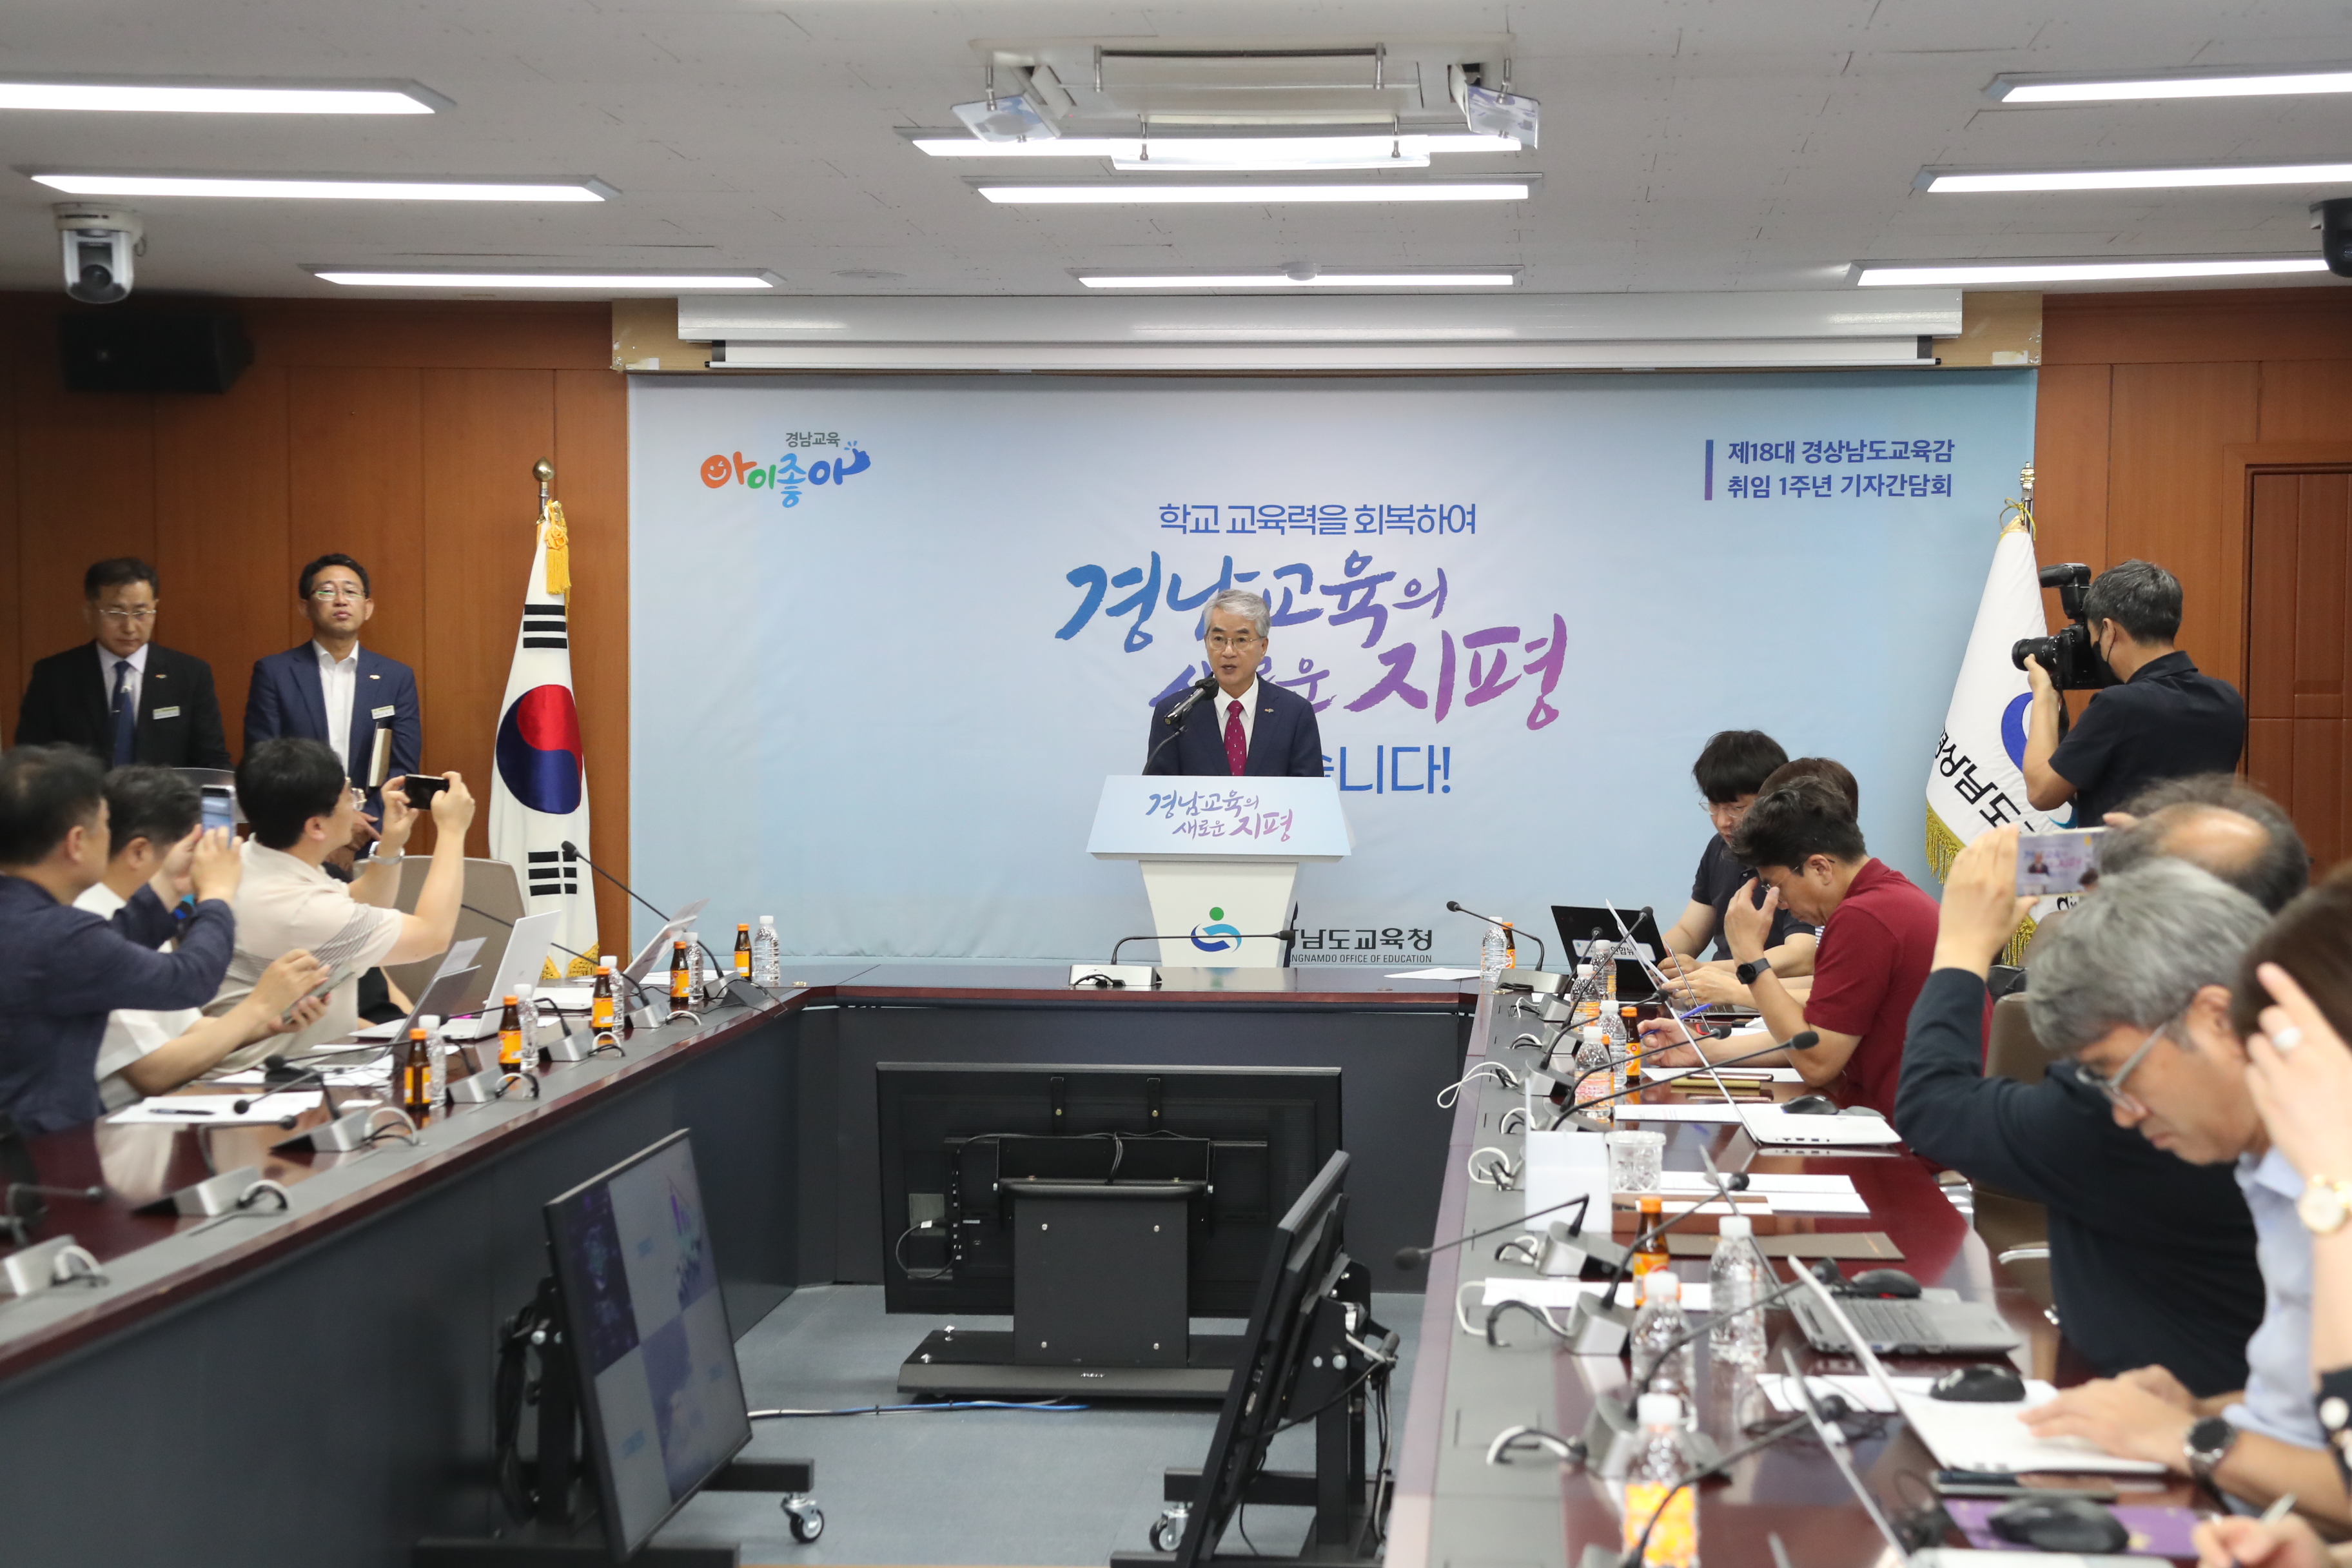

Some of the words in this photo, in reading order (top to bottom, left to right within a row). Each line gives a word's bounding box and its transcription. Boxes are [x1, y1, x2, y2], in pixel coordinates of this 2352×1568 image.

[785, 431, 841, 448] 경남교육
[1728, 440, 1795, 464] 제18대
[1801, 439, 1955, 464] 경상남도교육감
[700, 449, 872, 508] 아이좋아
[1727, 475, 1770, 499] 취임
[1779, 474, 1832, 498] 1주년
[1840, 473, 1952, 498] 기자간담회
[1159, 503, 1220, 535] 학교
[1226, 504, 1348, 536] 교육력을
[1354, 504, 1476, 535] 회복하여
[1343, 612, 1567, 730] 지평
[1145, 789, 1260, 819] 경남교육의
[1171, 818, 1226, 841] 새로운
[1228, 808, 1293, 842] 지평
[1294, 927, 1433, 952] 남도교육청
[1289, 954, 1337, 963] NGNAMDO
[1340, 954, 1368, 963] OFFICE
[1370, 954, 1381, 963] OF
[1384, 954, 1432, 963] EDUCATION
